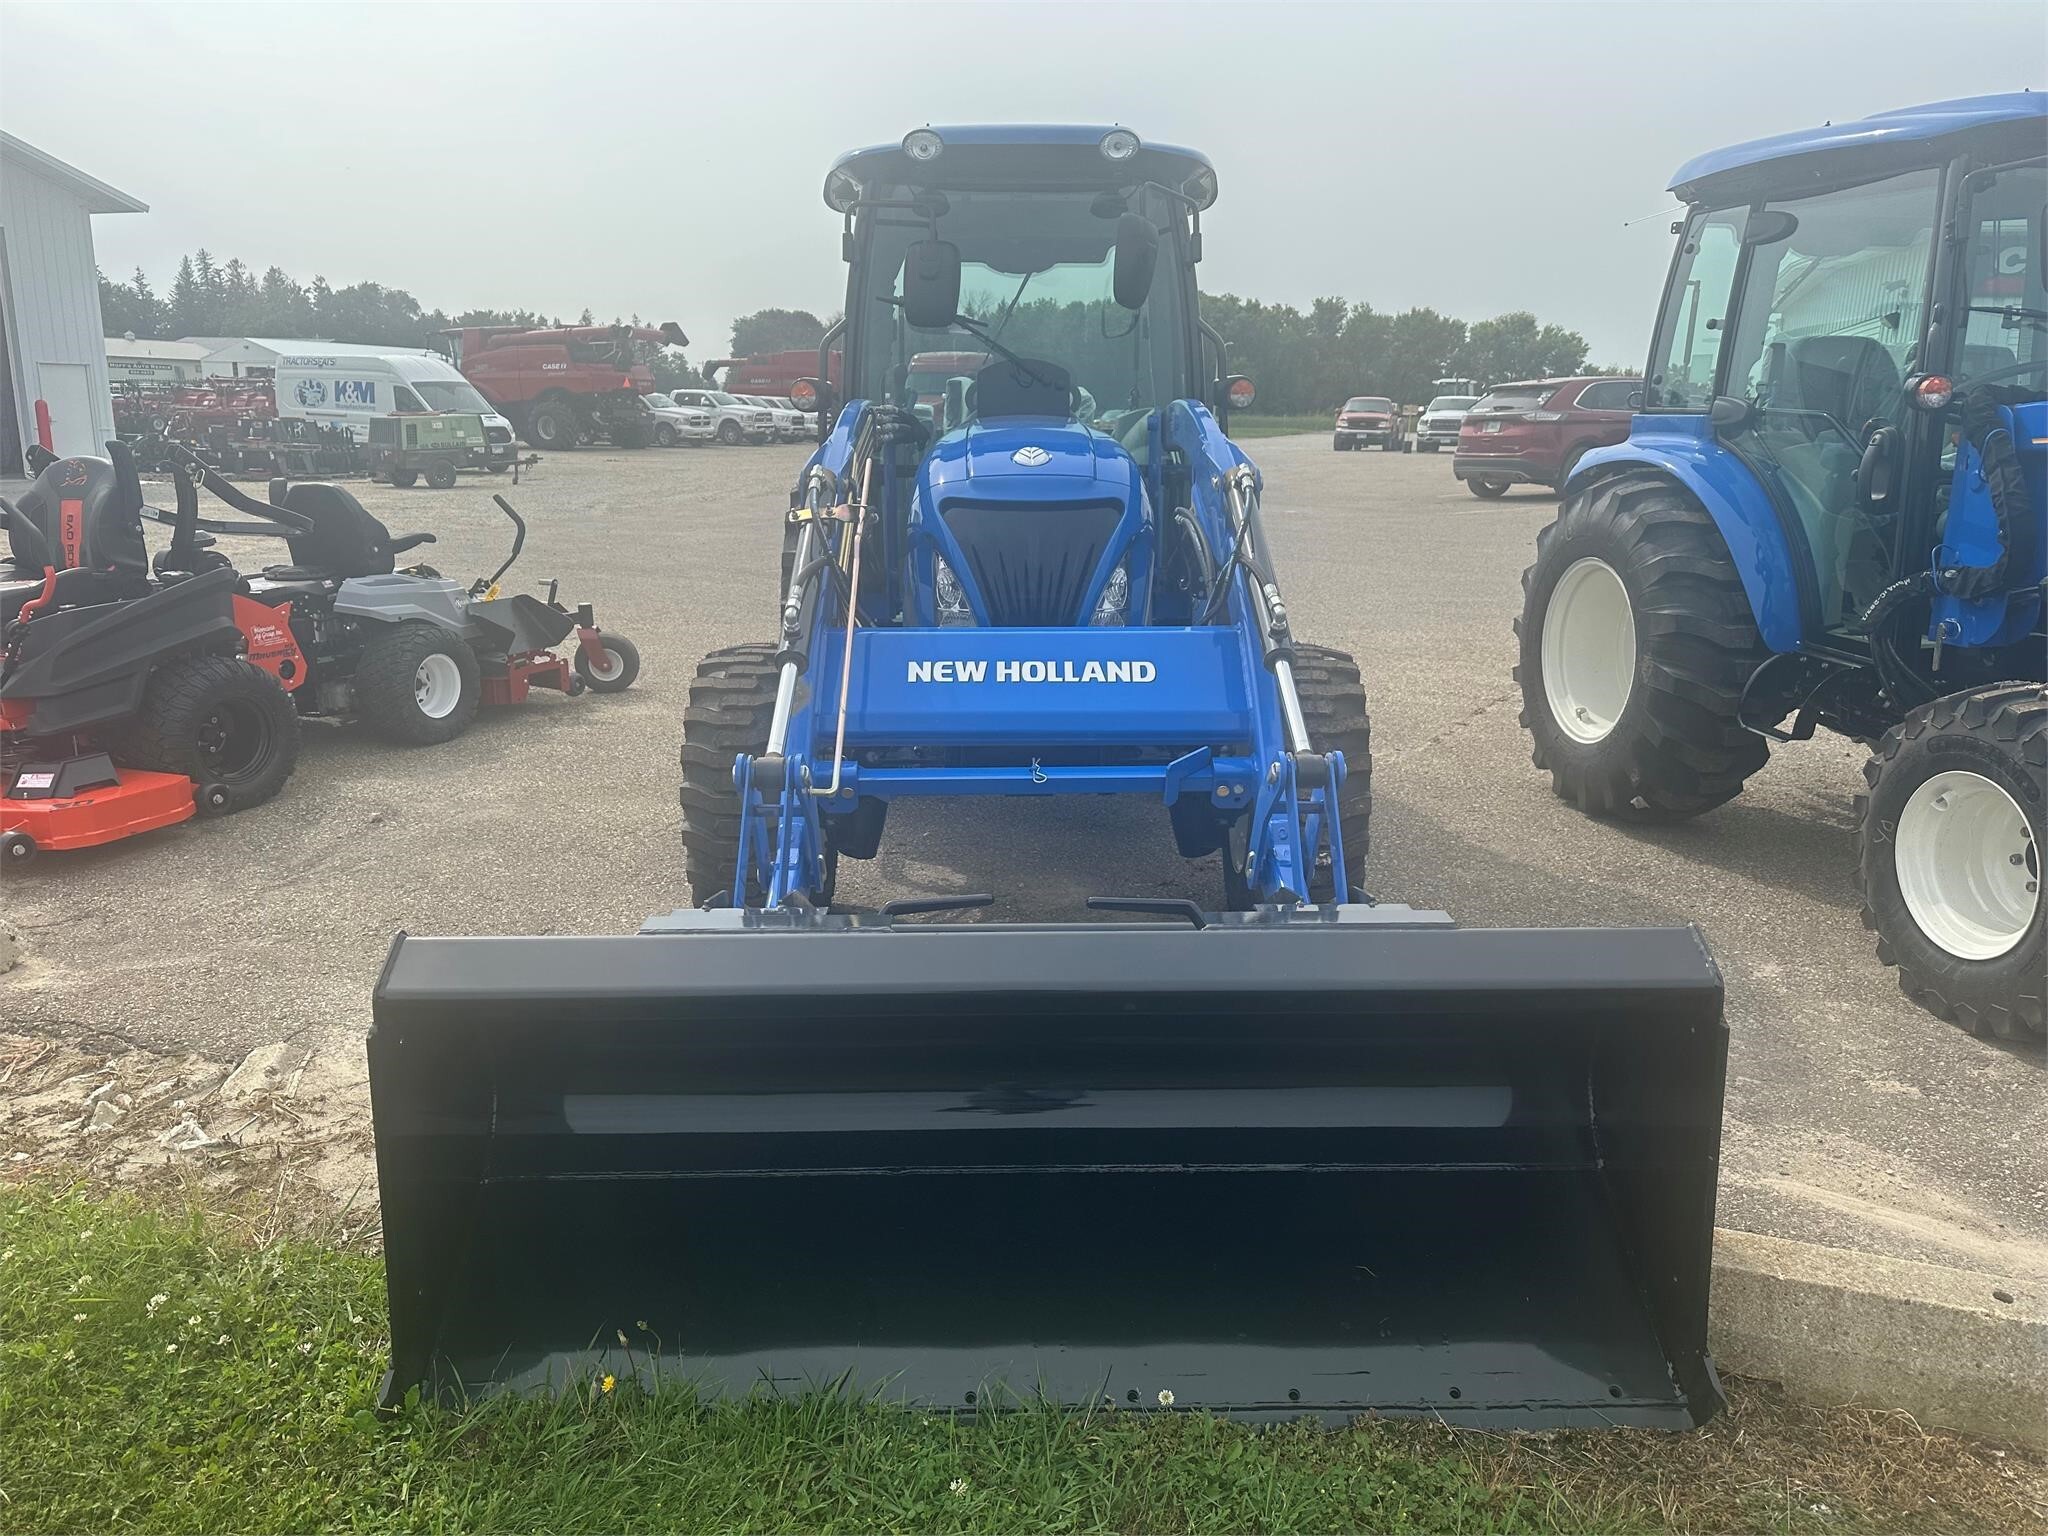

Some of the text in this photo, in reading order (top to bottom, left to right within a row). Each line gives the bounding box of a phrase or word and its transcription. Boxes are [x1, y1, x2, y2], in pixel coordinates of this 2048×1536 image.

[282, 357, 336, 367] TRACTORSEATS
[335, 380, 375, 404] K&M
[907, 660, 1157, 683] NEW HOLLAND
